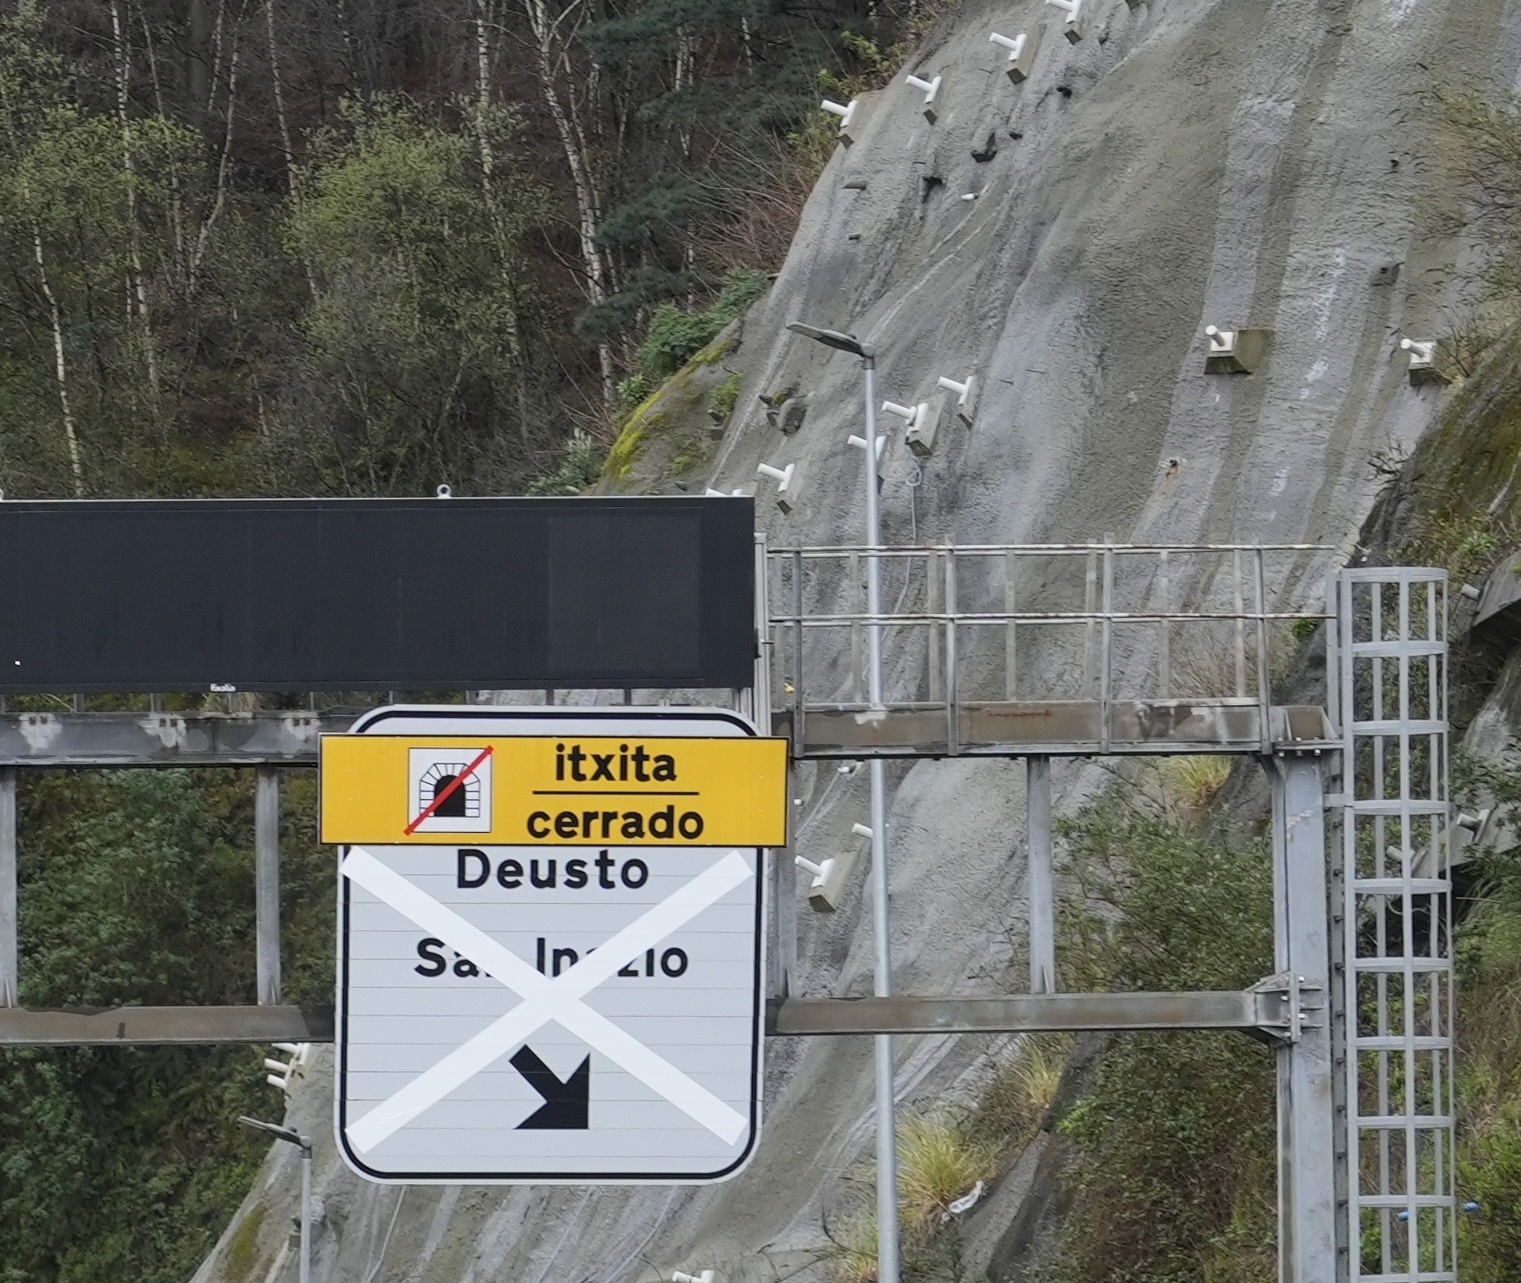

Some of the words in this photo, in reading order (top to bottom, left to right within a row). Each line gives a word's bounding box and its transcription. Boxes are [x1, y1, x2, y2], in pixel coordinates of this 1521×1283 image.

[555, 743, 678, 783] itxita
[526, 804, 704, 840] cerrado
[457, 849, 649, 889] Deusto
[414, 937, 494, 978] Sa
[536, 937, 689, 978] Inzio
